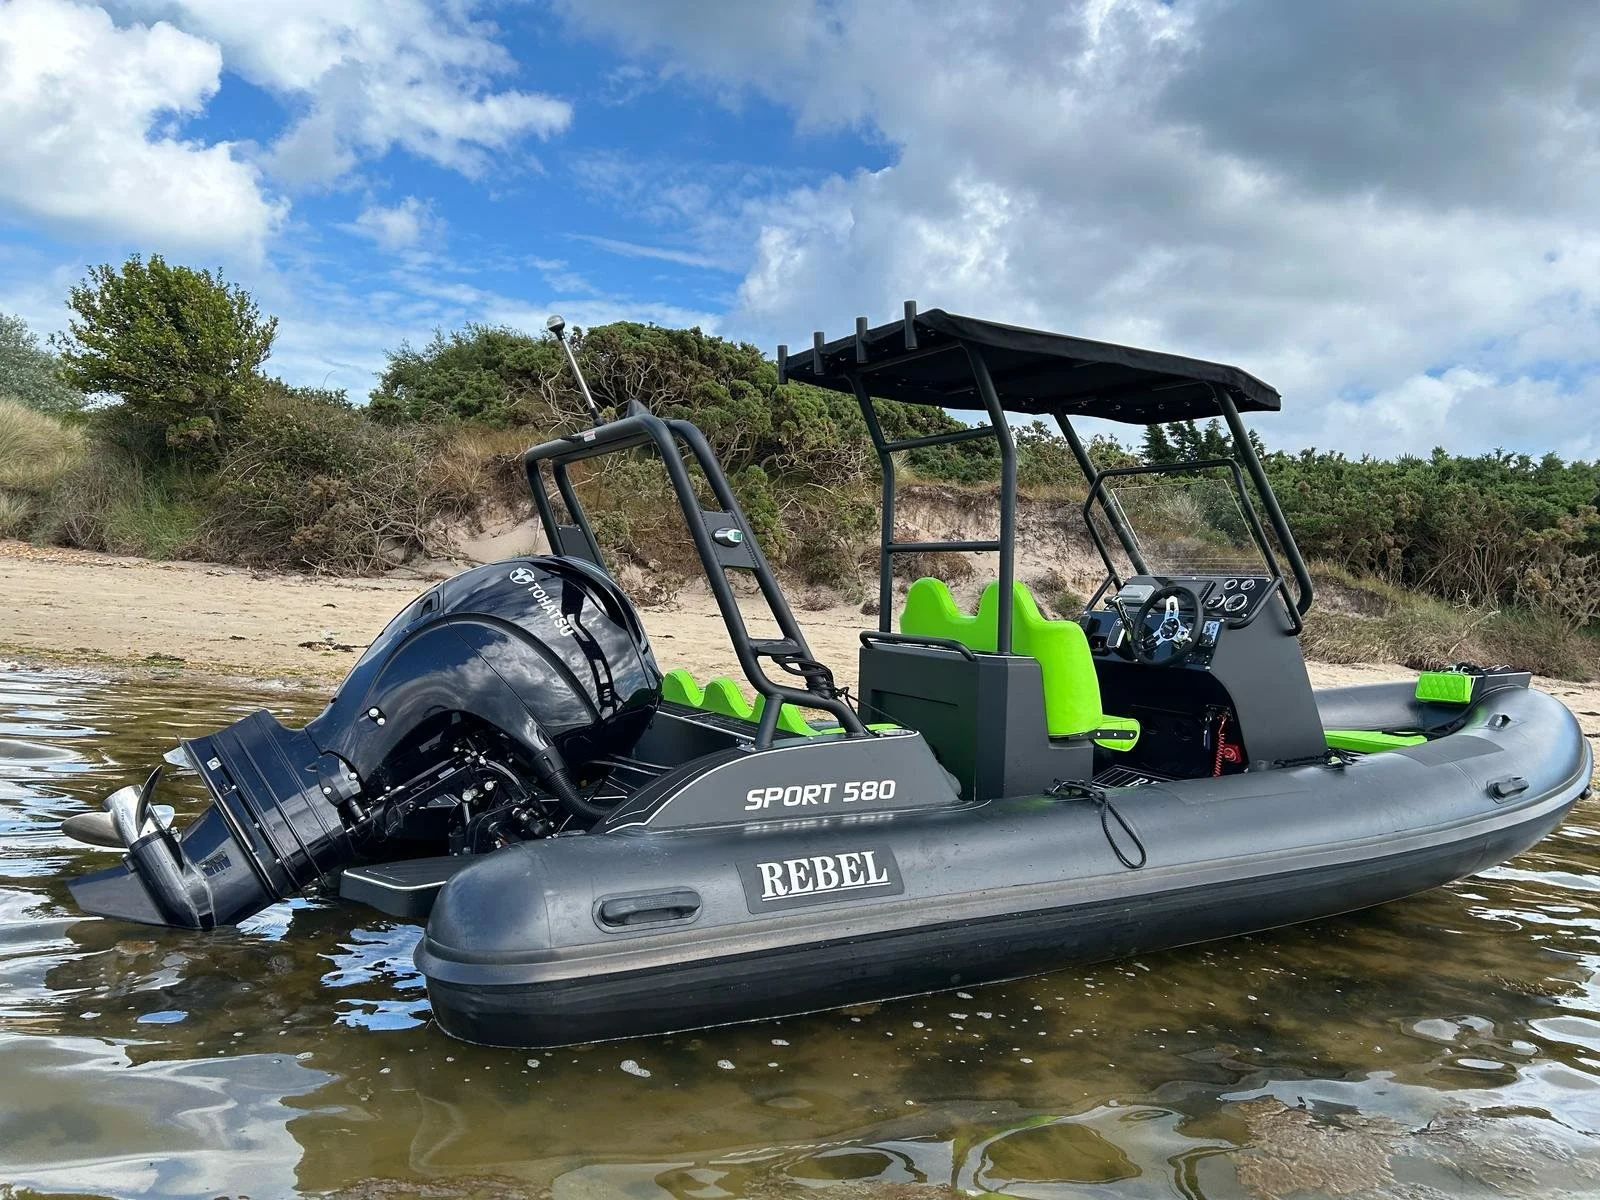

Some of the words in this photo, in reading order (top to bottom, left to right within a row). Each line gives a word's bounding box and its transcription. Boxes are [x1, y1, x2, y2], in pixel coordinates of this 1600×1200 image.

[527, 582, 574, 636] TOHATSU
[744, 783, 837, 811] SPORT
[843, 780, 896, 803] 580
[756, 851, 889, 898] REBEL
